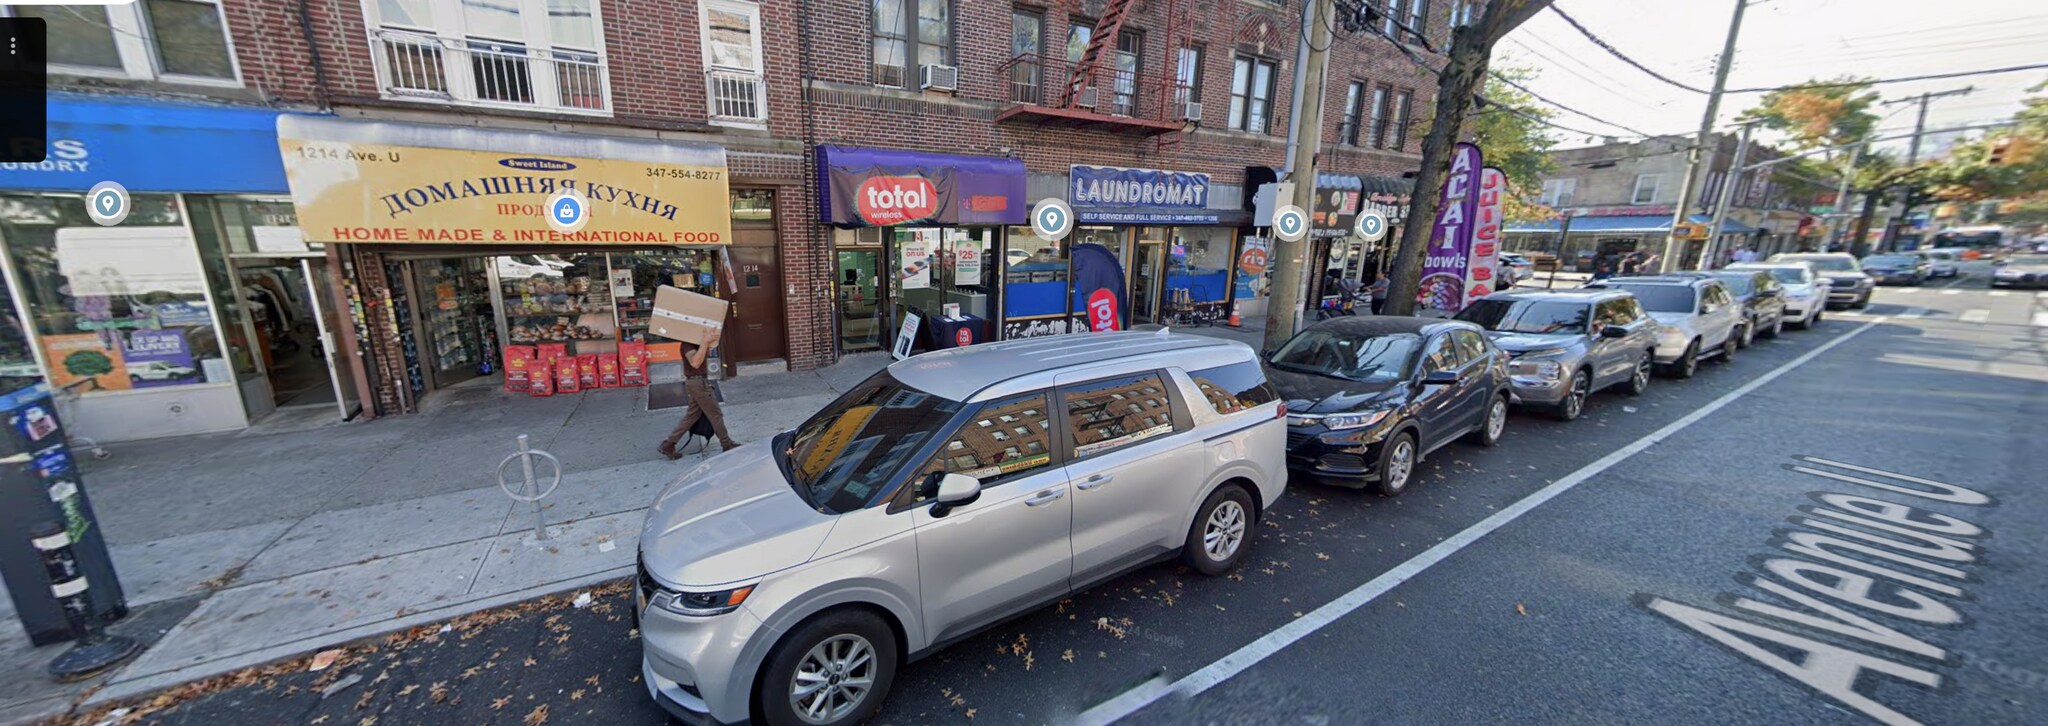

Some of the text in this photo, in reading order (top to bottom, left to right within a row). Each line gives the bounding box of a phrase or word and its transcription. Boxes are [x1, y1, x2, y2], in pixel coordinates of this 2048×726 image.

[297, 146, 400, 163] 1214 Ave. U
[0, 161, 88, 172] UNDRY
[508, 159, 568, 169] Sweet Island
[646, 167, 721, 181] 347-554-8277
[380, 176, 679, 221] ДОМАШНЯЯ КУХНЯ
[867, 182, 927, 209] total
[1075, 178, 1204, 205] LAUNDROMAT
[1440, 148, 1472, 249] ACAI
[871, 210, 903, 219] wireless
[333, 227, 720, 243] HOME MADE & INTERNATIONAL FOOD
[1468, 173, 1499, 304] JUICE BA
[1424, 253, 1467, 268] bowls
[1649, 455, 1991, 726] Avenue U
